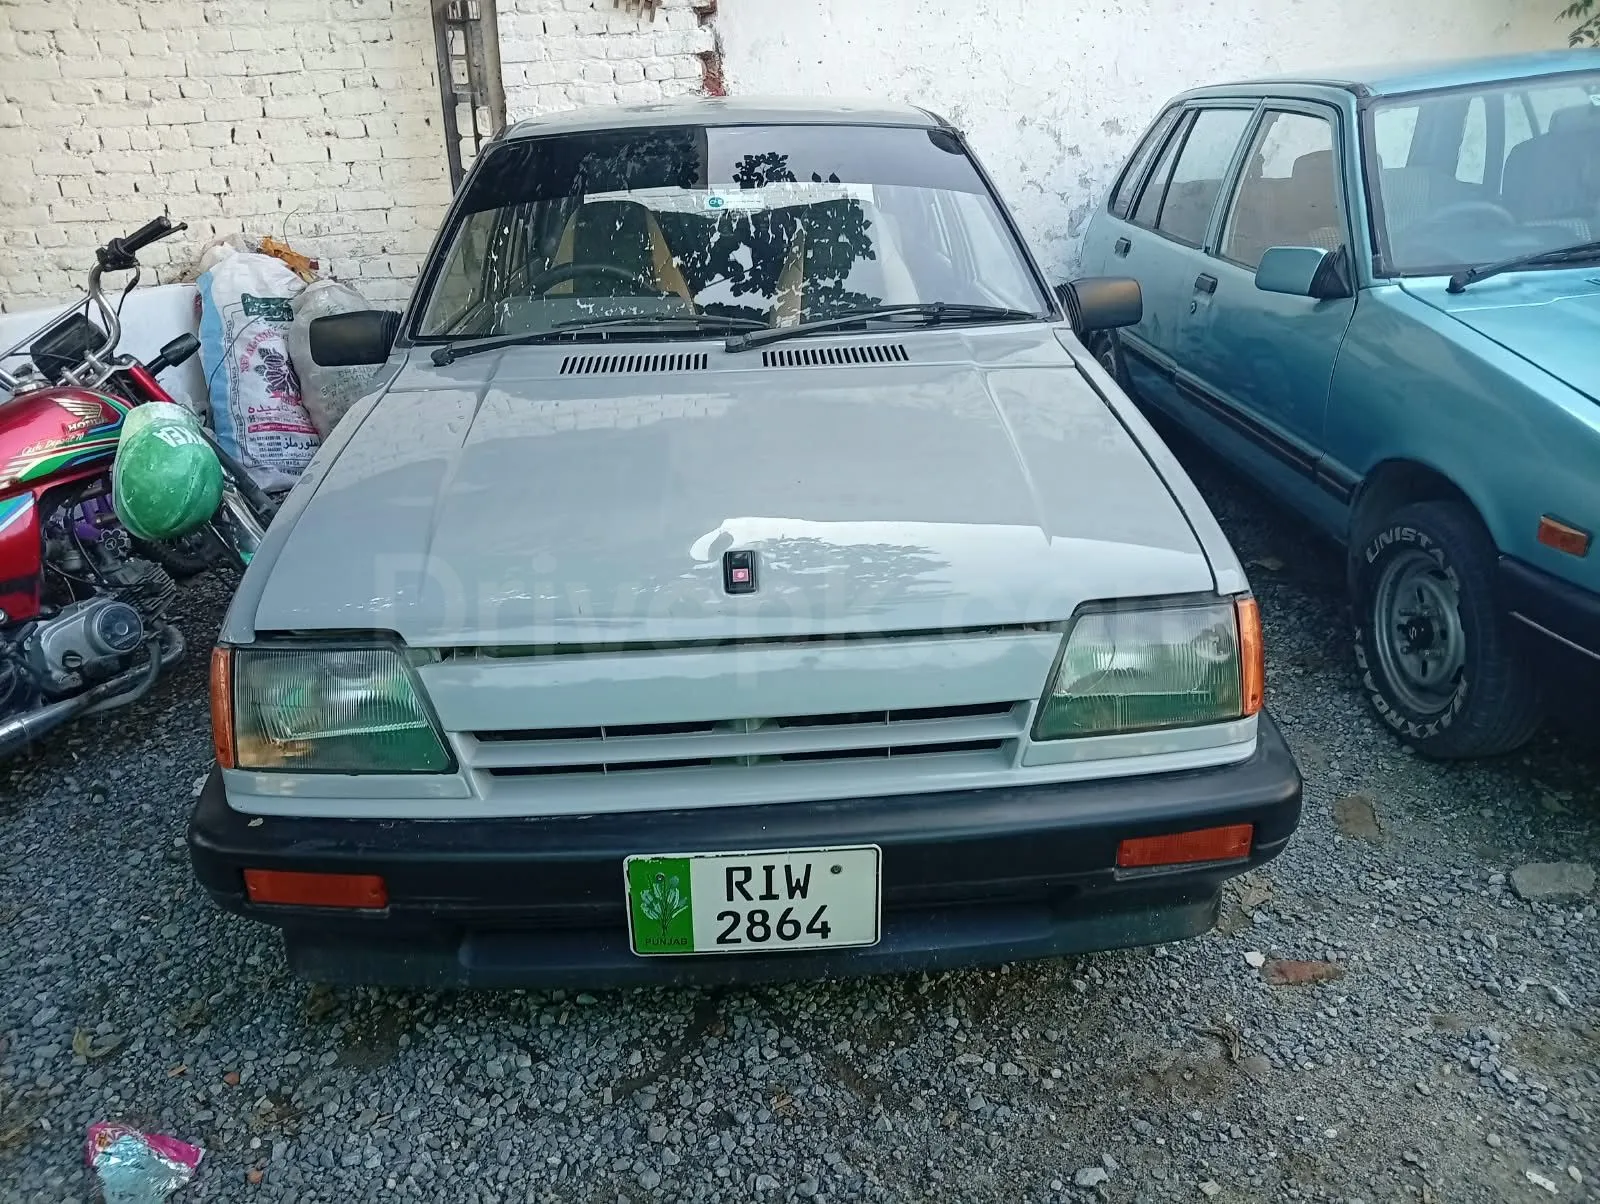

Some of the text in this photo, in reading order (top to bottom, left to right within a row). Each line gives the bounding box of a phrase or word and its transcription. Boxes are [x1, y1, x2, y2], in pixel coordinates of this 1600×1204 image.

[725, 863, 812, 902] RIW
[645, 937, 688, 946] PUNJAB
[716, 904, 832, 945] 2864
